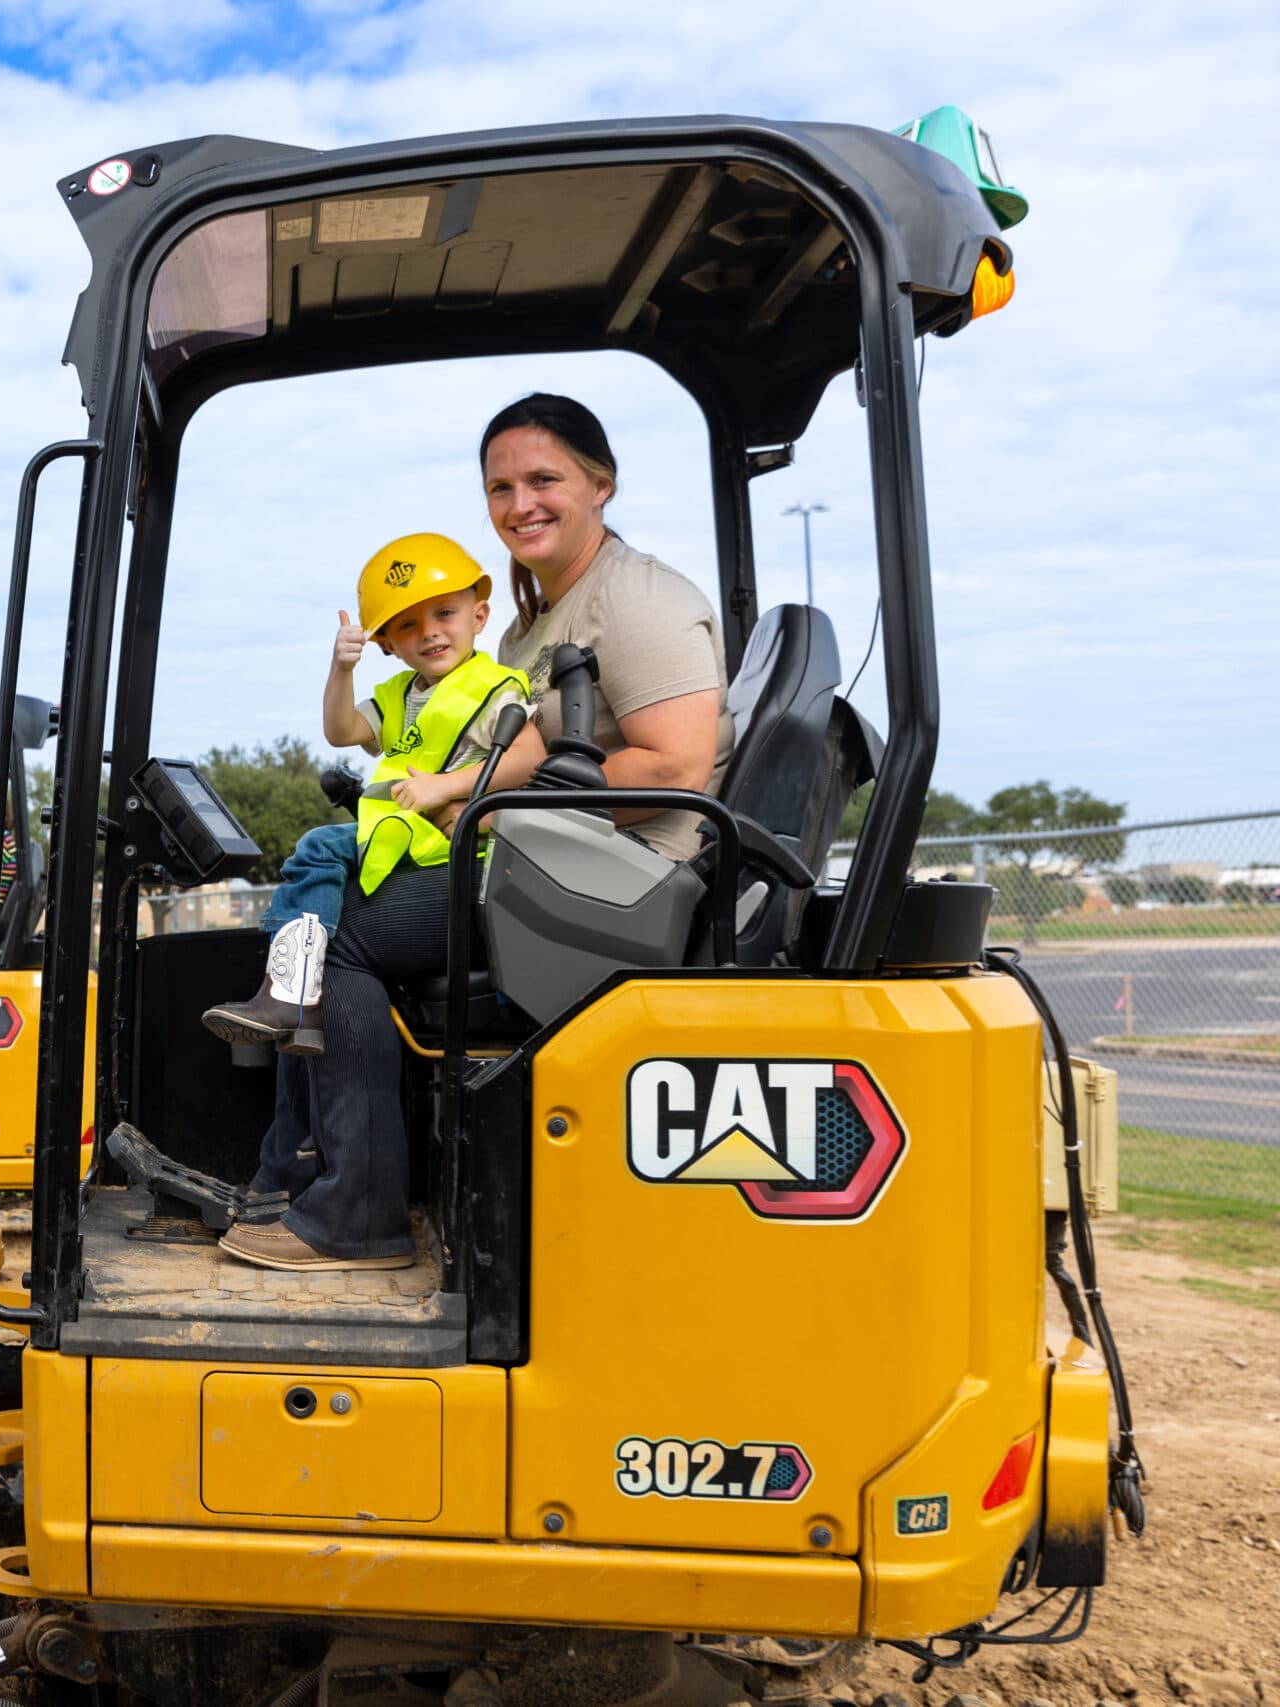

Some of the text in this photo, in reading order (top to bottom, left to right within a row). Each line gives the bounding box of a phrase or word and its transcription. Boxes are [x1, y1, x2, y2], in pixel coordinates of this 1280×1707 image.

[630, 1061, 833, 1181] CAT
[619, 1440, 777, 1497] 302.7
[908, 1502, 940, 1530] CR
